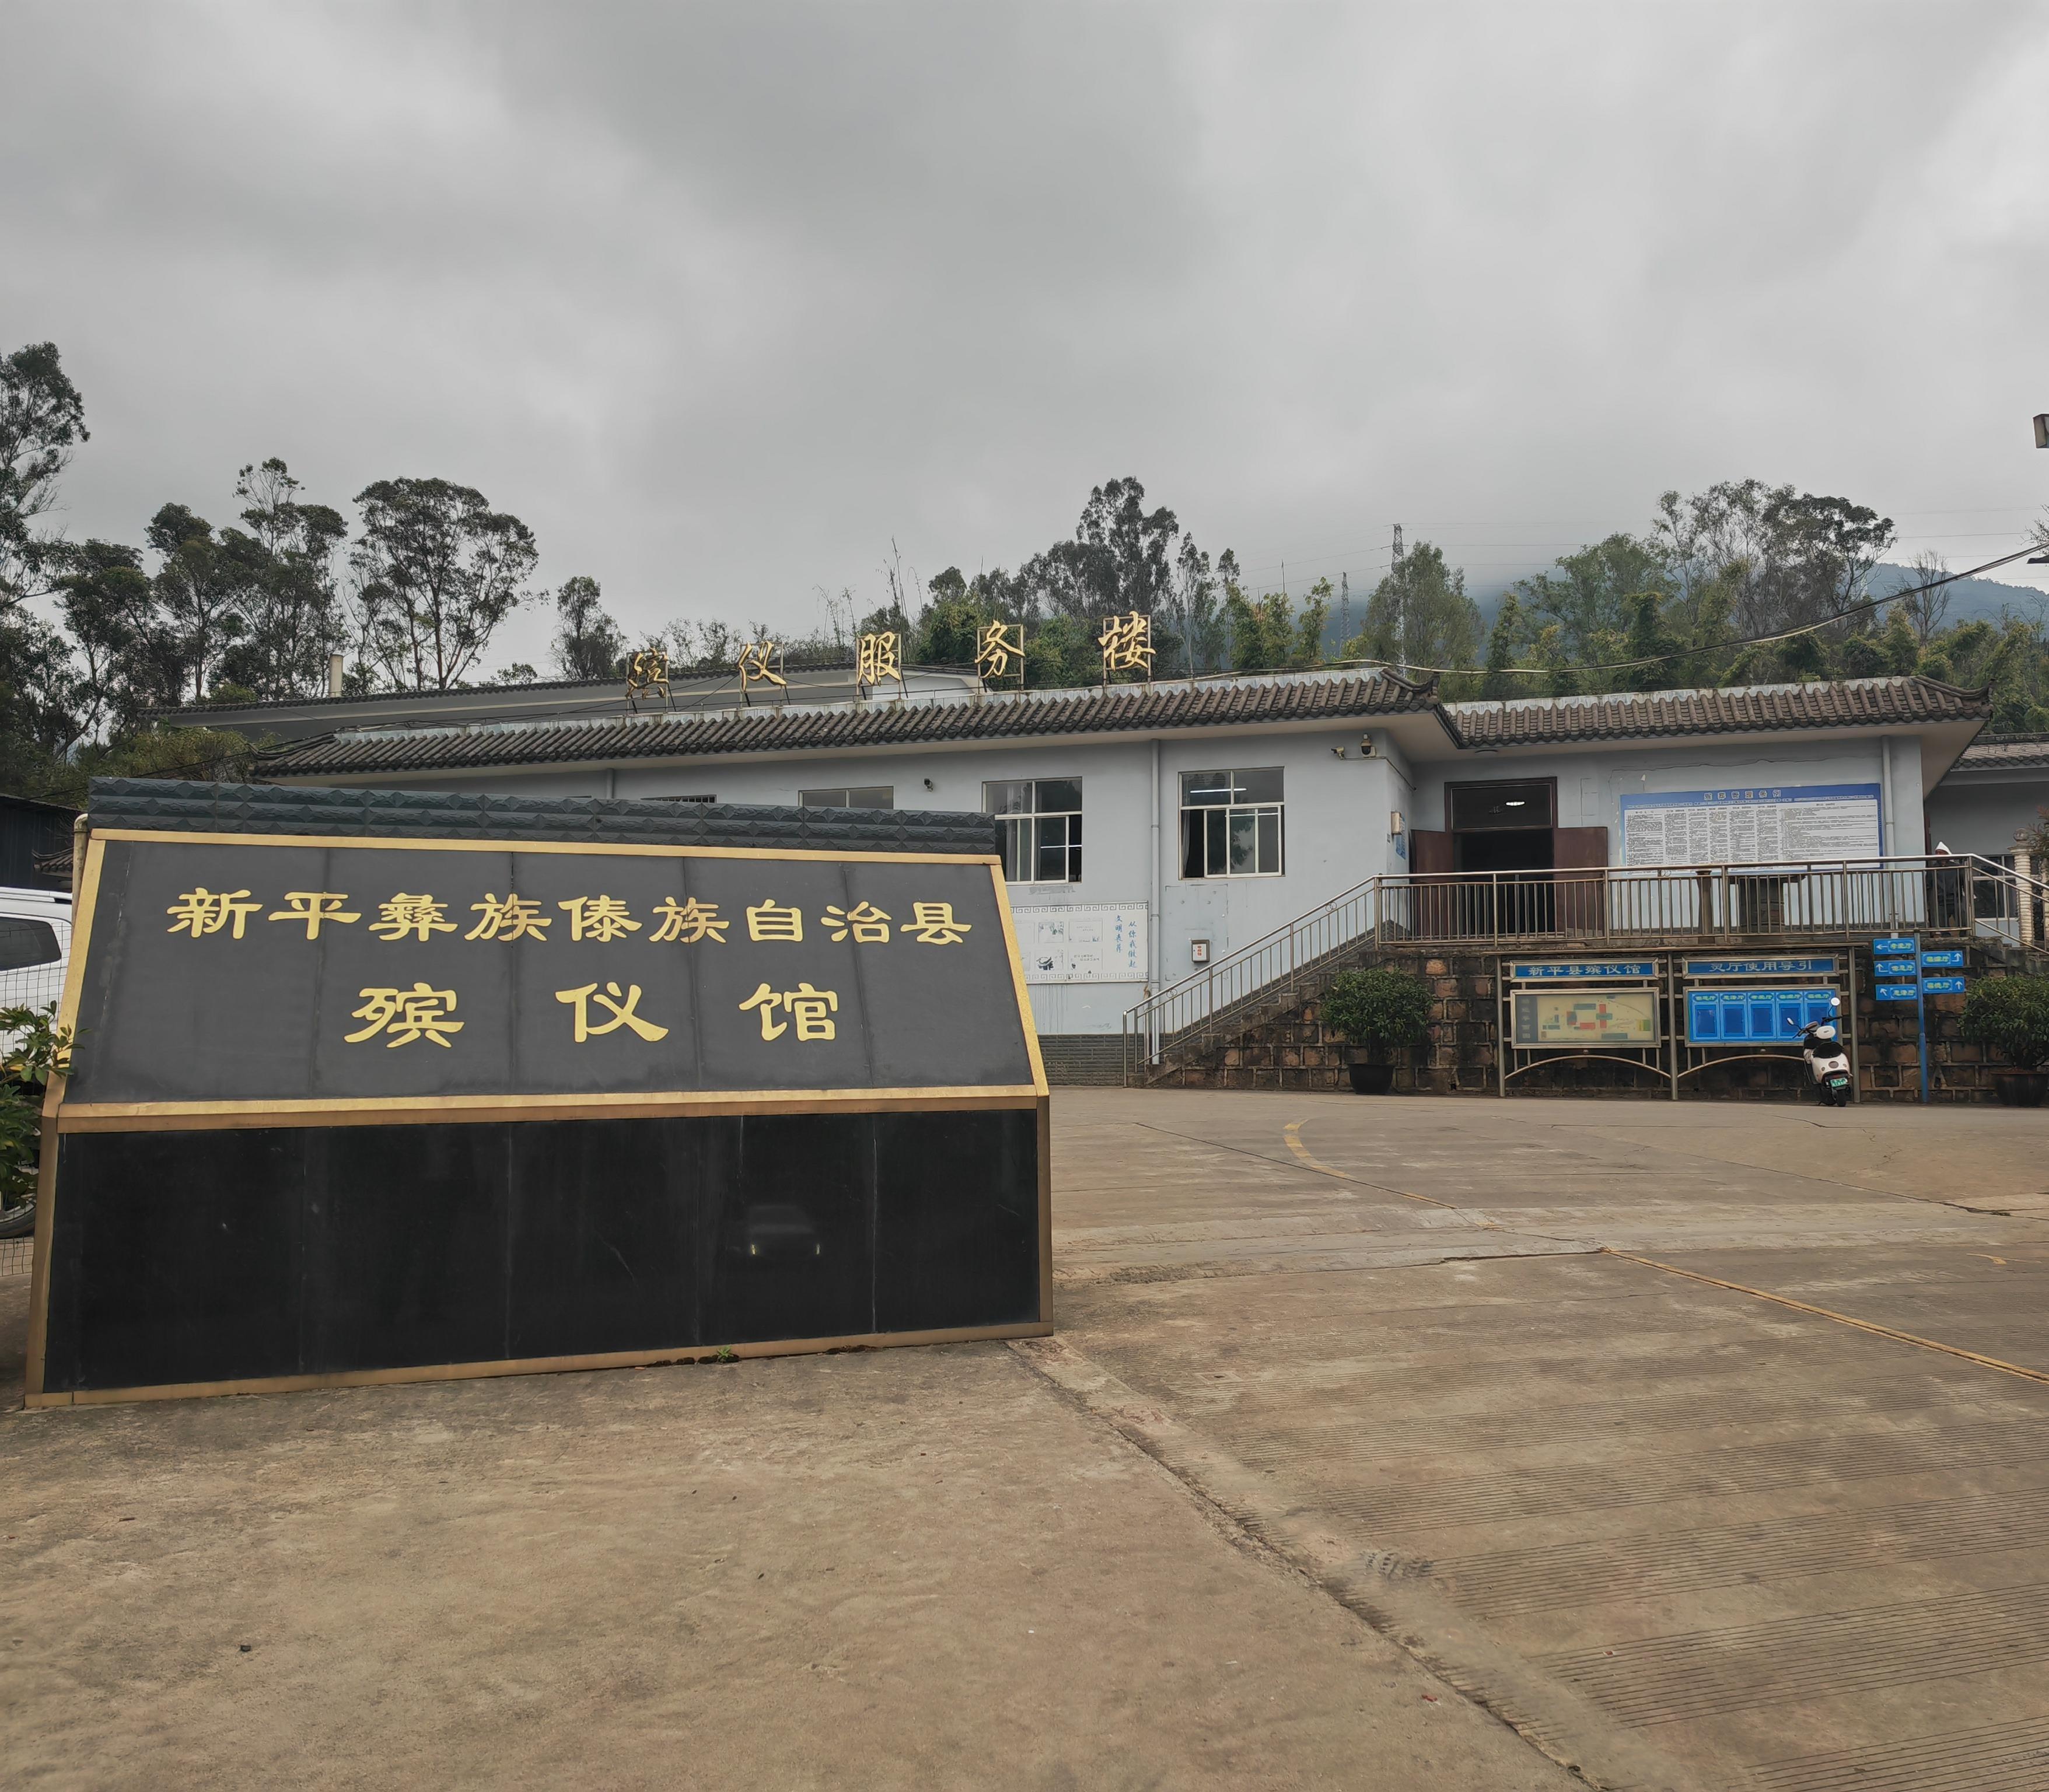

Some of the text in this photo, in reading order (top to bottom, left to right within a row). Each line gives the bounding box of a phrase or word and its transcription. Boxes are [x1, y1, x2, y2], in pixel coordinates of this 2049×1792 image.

[167, 888, 971, 944] 新平彝族傣族自治县
[1527, 964, 1641, 976] 新平县殡仪馆
[1709, 960, 1812, 972] 灵厅使用导引
[344, 982, 838, 1048] 殡仪馆
